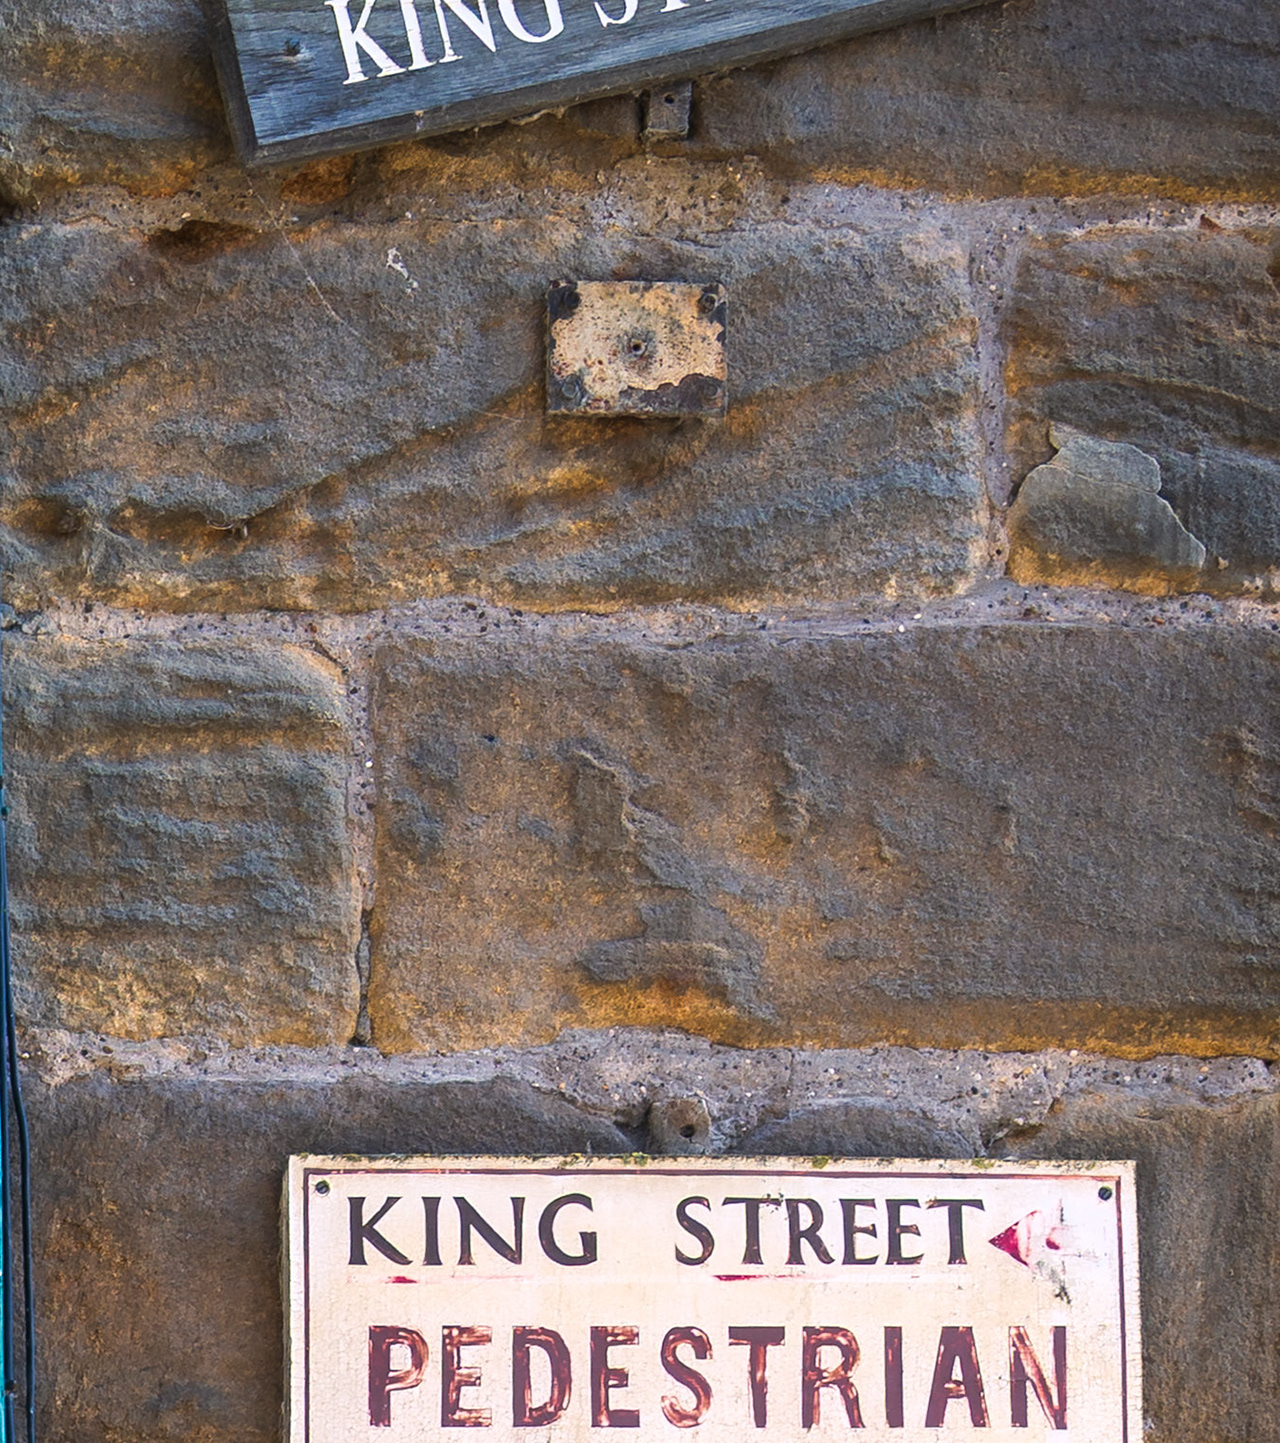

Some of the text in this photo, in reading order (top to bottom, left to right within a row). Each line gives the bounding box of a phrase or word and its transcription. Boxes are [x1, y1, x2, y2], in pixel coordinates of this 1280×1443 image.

[347, 1194, 986, 1267] KING STREET
[367, 1324, 1069, 1430] PEDESTRIAN
